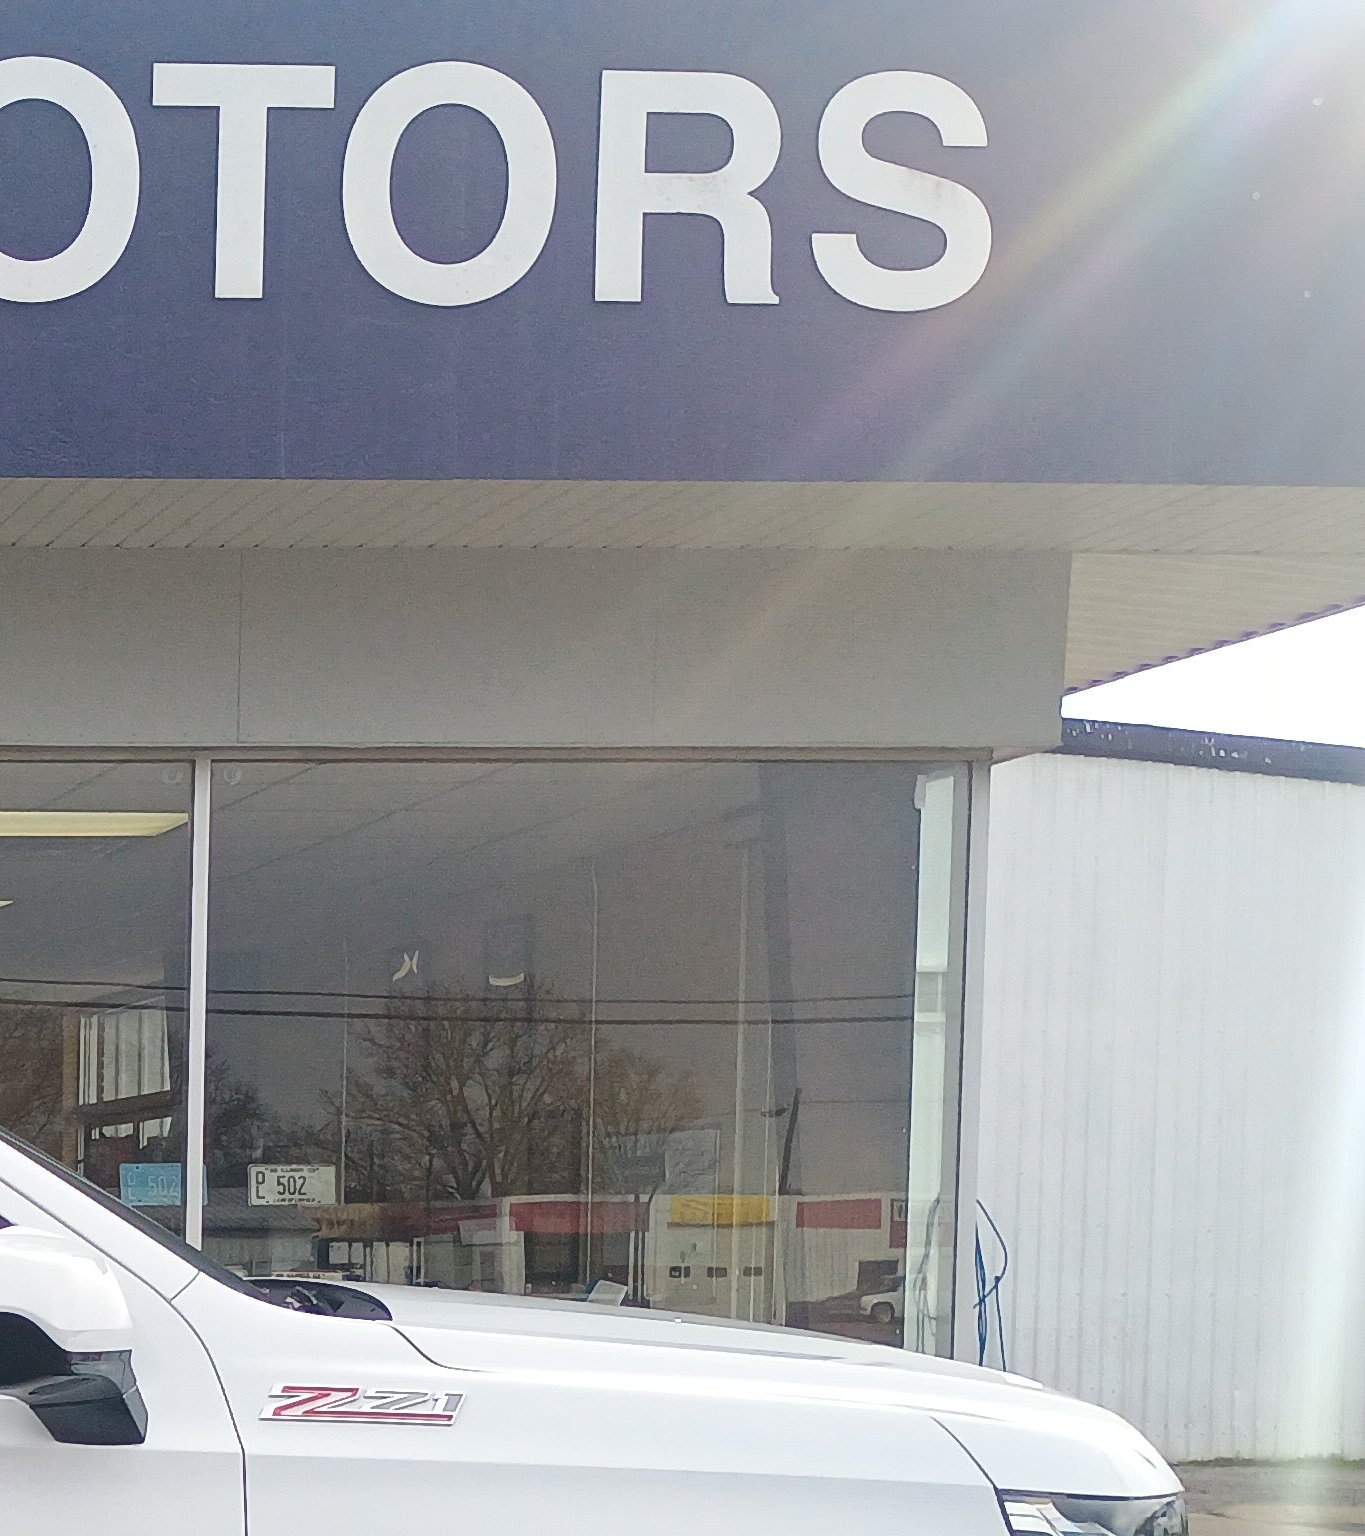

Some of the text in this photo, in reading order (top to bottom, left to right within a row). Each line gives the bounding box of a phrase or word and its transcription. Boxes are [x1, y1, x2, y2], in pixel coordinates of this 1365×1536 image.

[148, 1175, 178, 1196] 502
[276, 1175, 307, 1196] 502
[259, 1385, 466, 1426] Z71
